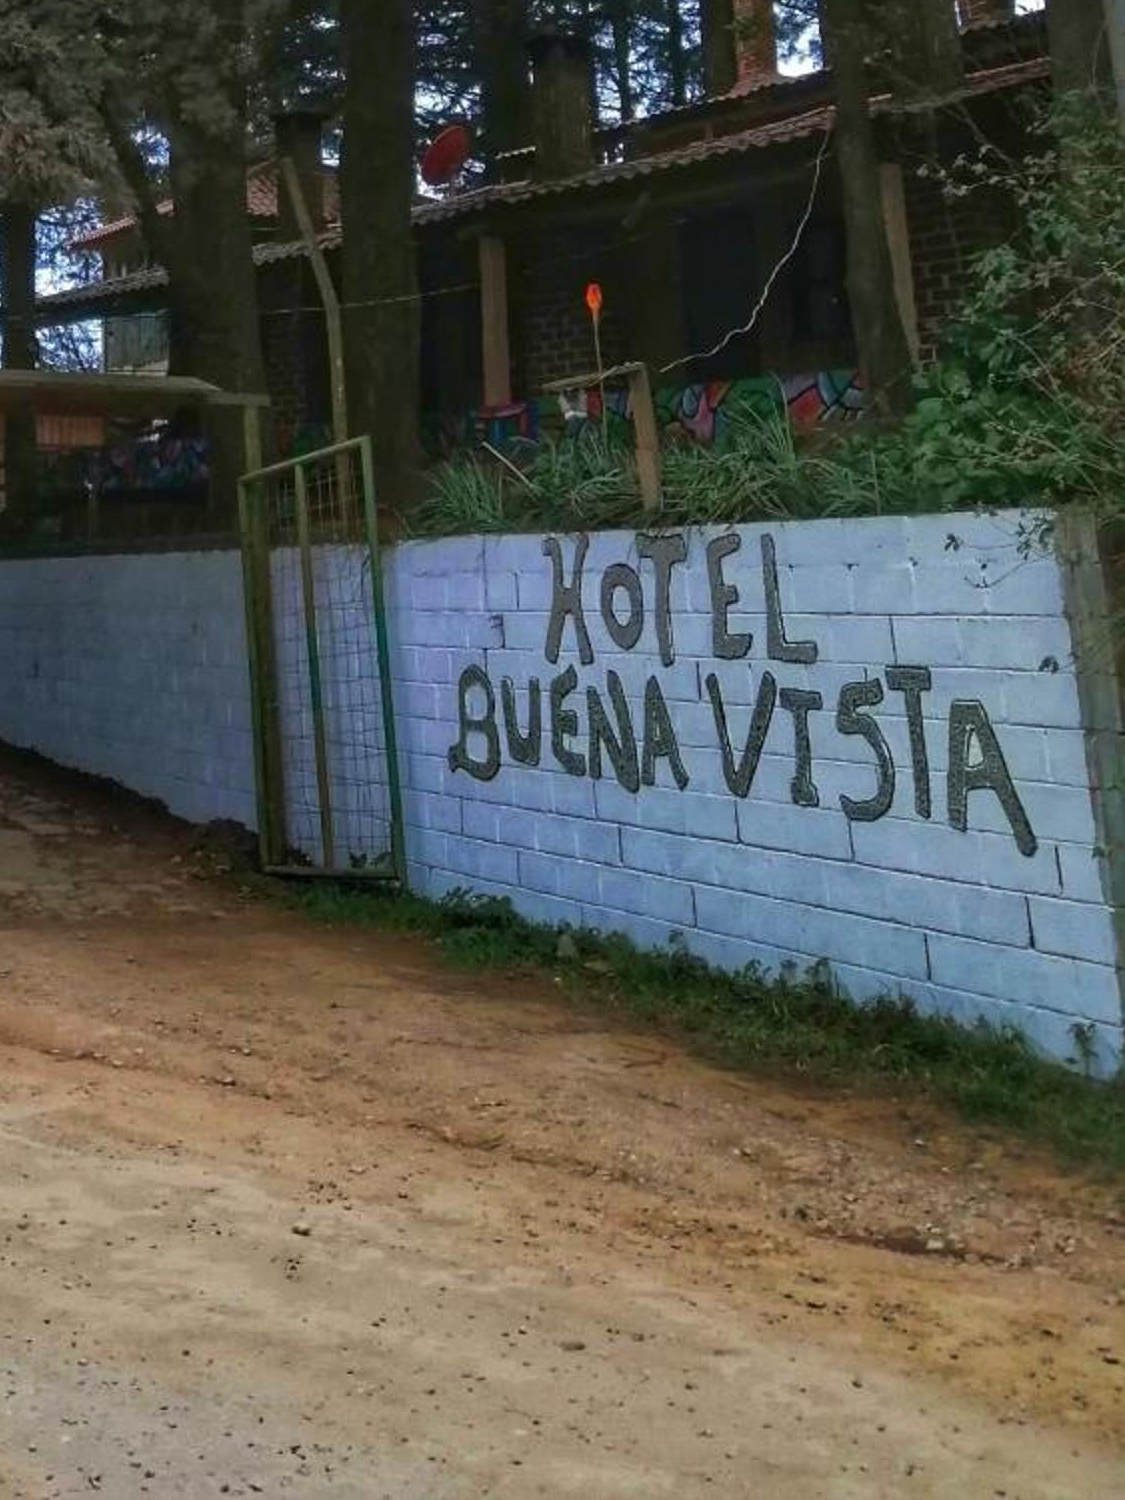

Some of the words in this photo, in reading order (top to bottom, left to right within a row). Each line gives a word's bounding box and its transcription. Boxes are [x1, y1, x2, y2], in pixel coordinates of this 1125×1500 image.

[543, 533, 818, 666] HOTEL
[448, 664, 689, 793] BUENA
[706, 665, 1038, 857] VISTA
